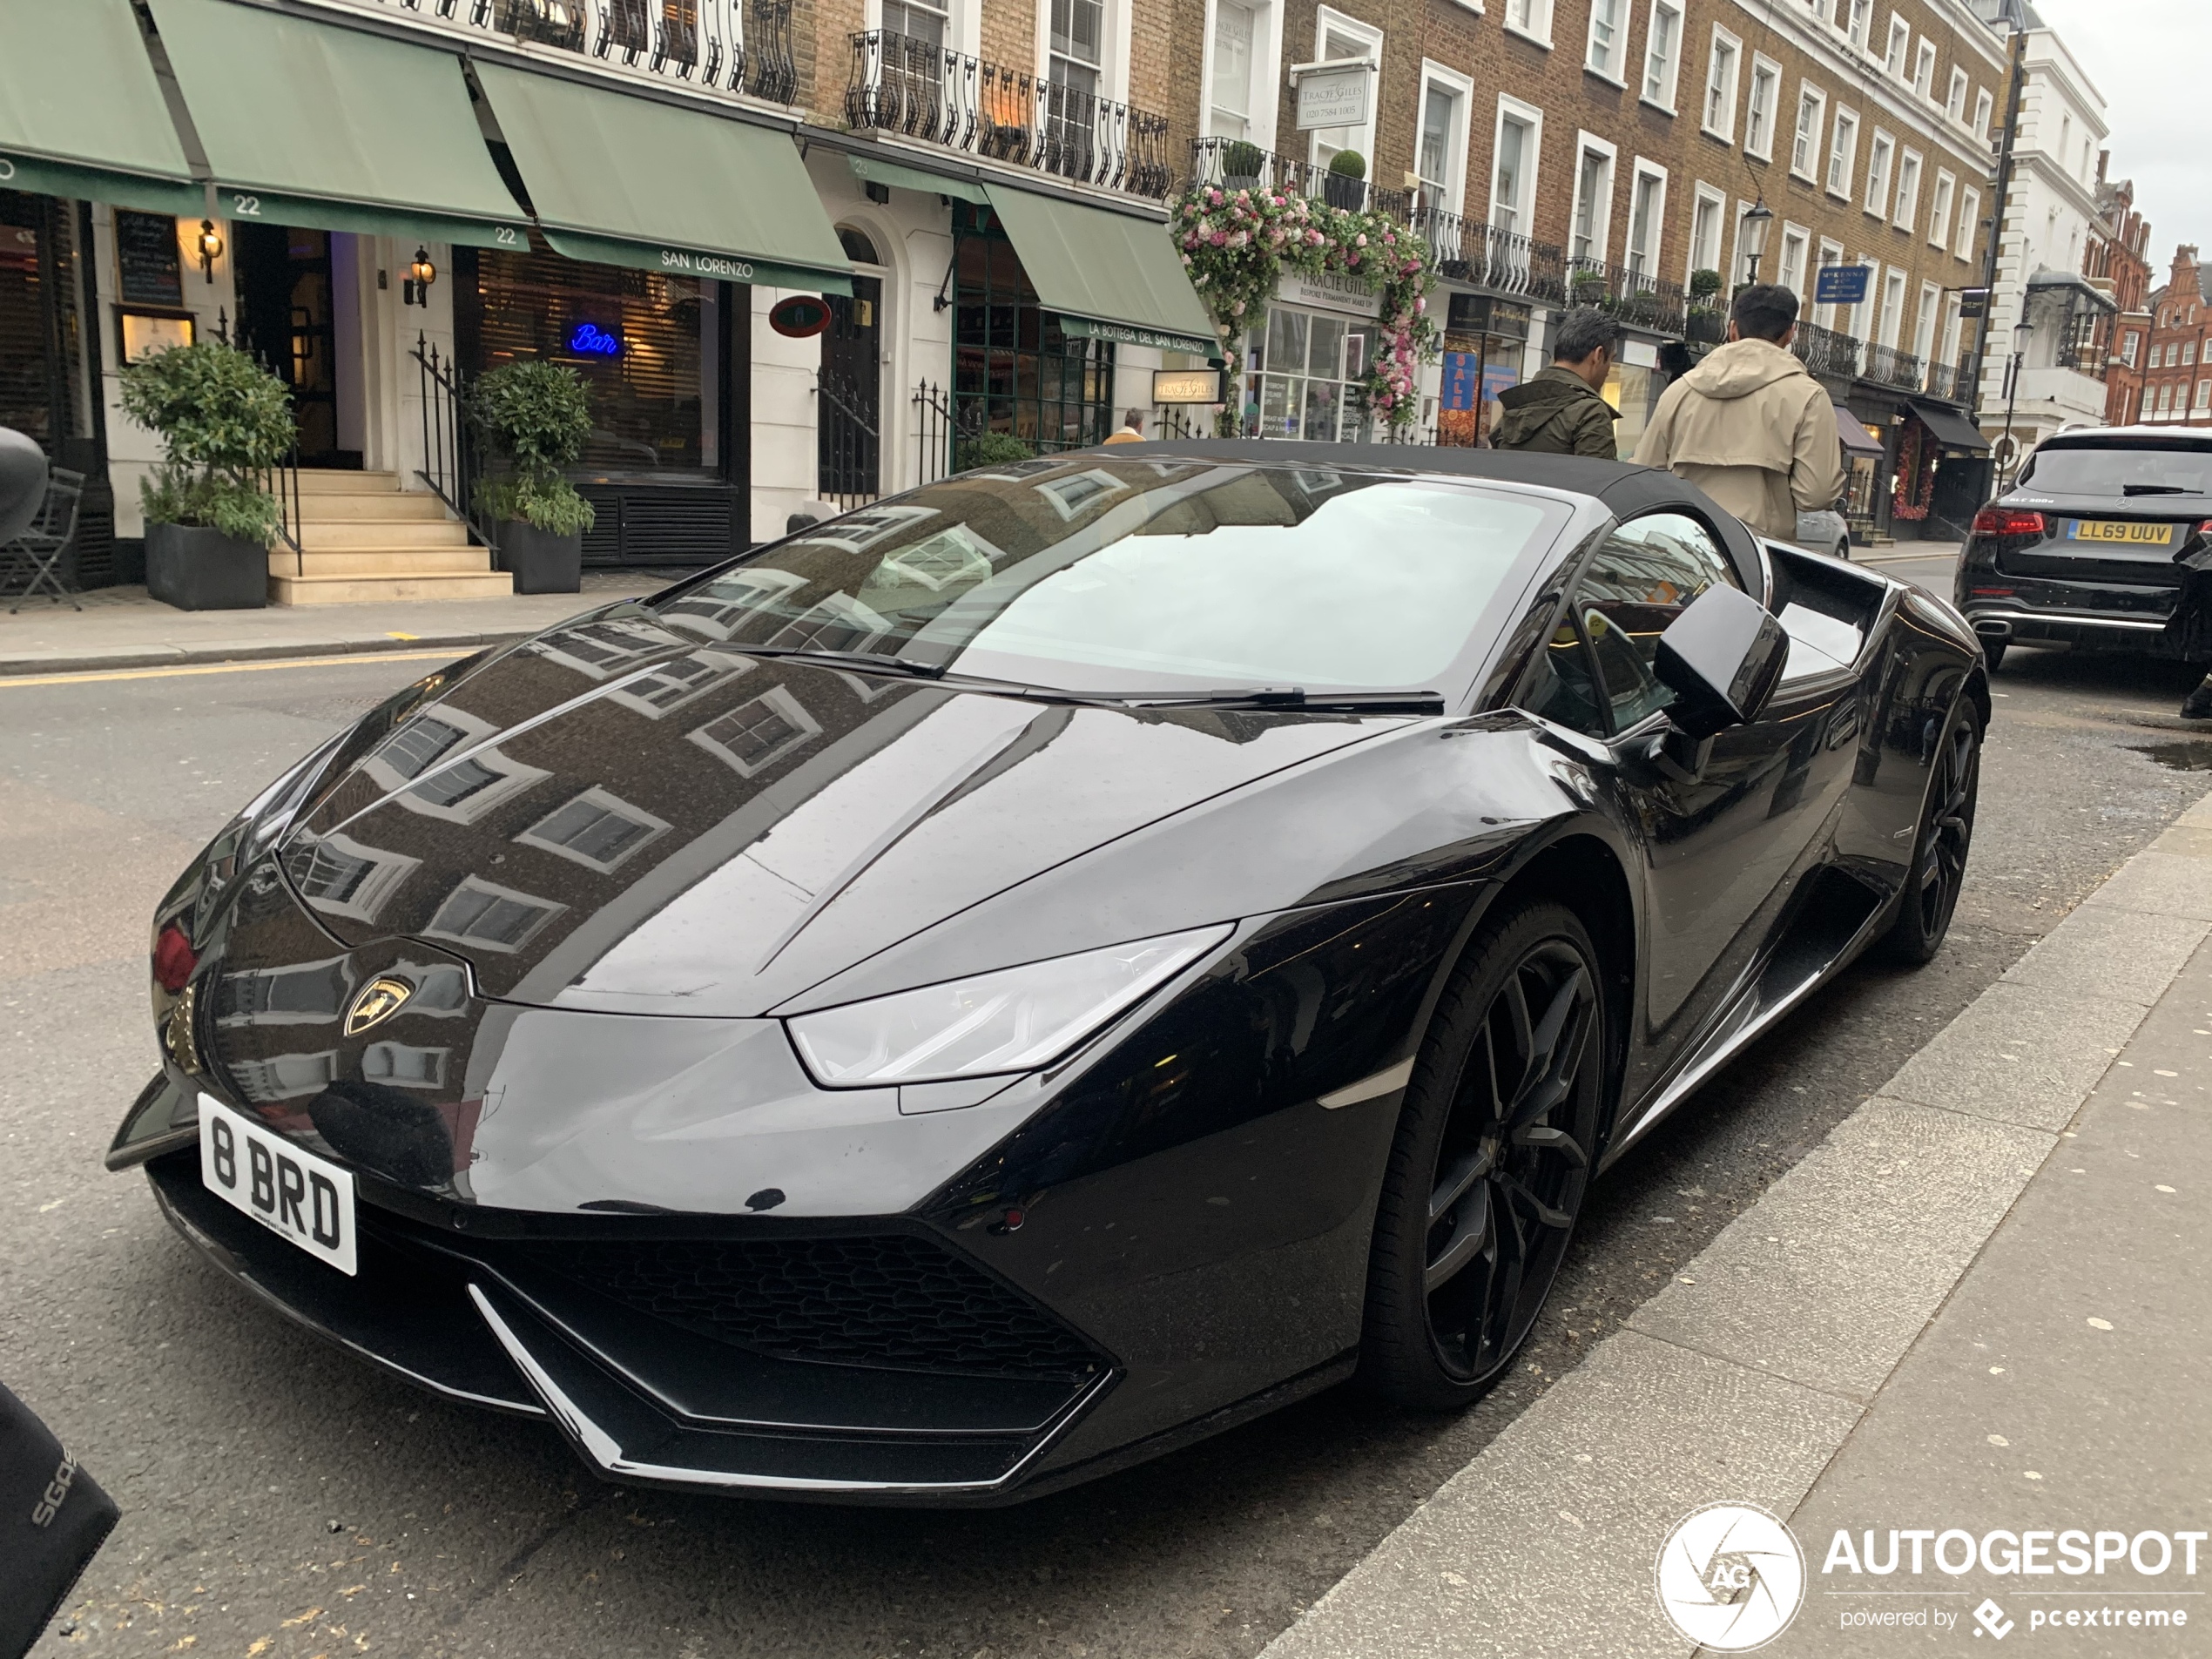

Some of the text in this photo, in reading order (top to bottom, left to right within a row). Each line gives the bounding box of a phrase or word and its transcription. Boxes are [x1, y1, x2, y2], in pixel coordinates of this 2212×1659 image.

[1337, 86, 1362, 98] GILES
[1306, 105, 1355, 118] 020 7584 1005
[234, 194, 260, 215] 22
[496, 226, 516, 245] 22
[662, 250, 753, 278] SAN LORENZO
[1304, 268, 1341, 291] TRACIE
[1300, 287, 1321, 299] BESPOKE
[1322, 292, 1351, 305] PERMANENT
[1352, 298, 1365, 307] MAKE
[571, 324, 617, 354] Bar
[1089, 322, 1204, 354] LA BOTTEGA DEL SAN LORENZO
[1190, 383, 1214, 394] GILES
[1453, 354, 1466, 408] SALE
[2079, 523, 2168, 542] LL69 UUV
[212, 1116, 341, 1251] 8 BRD
